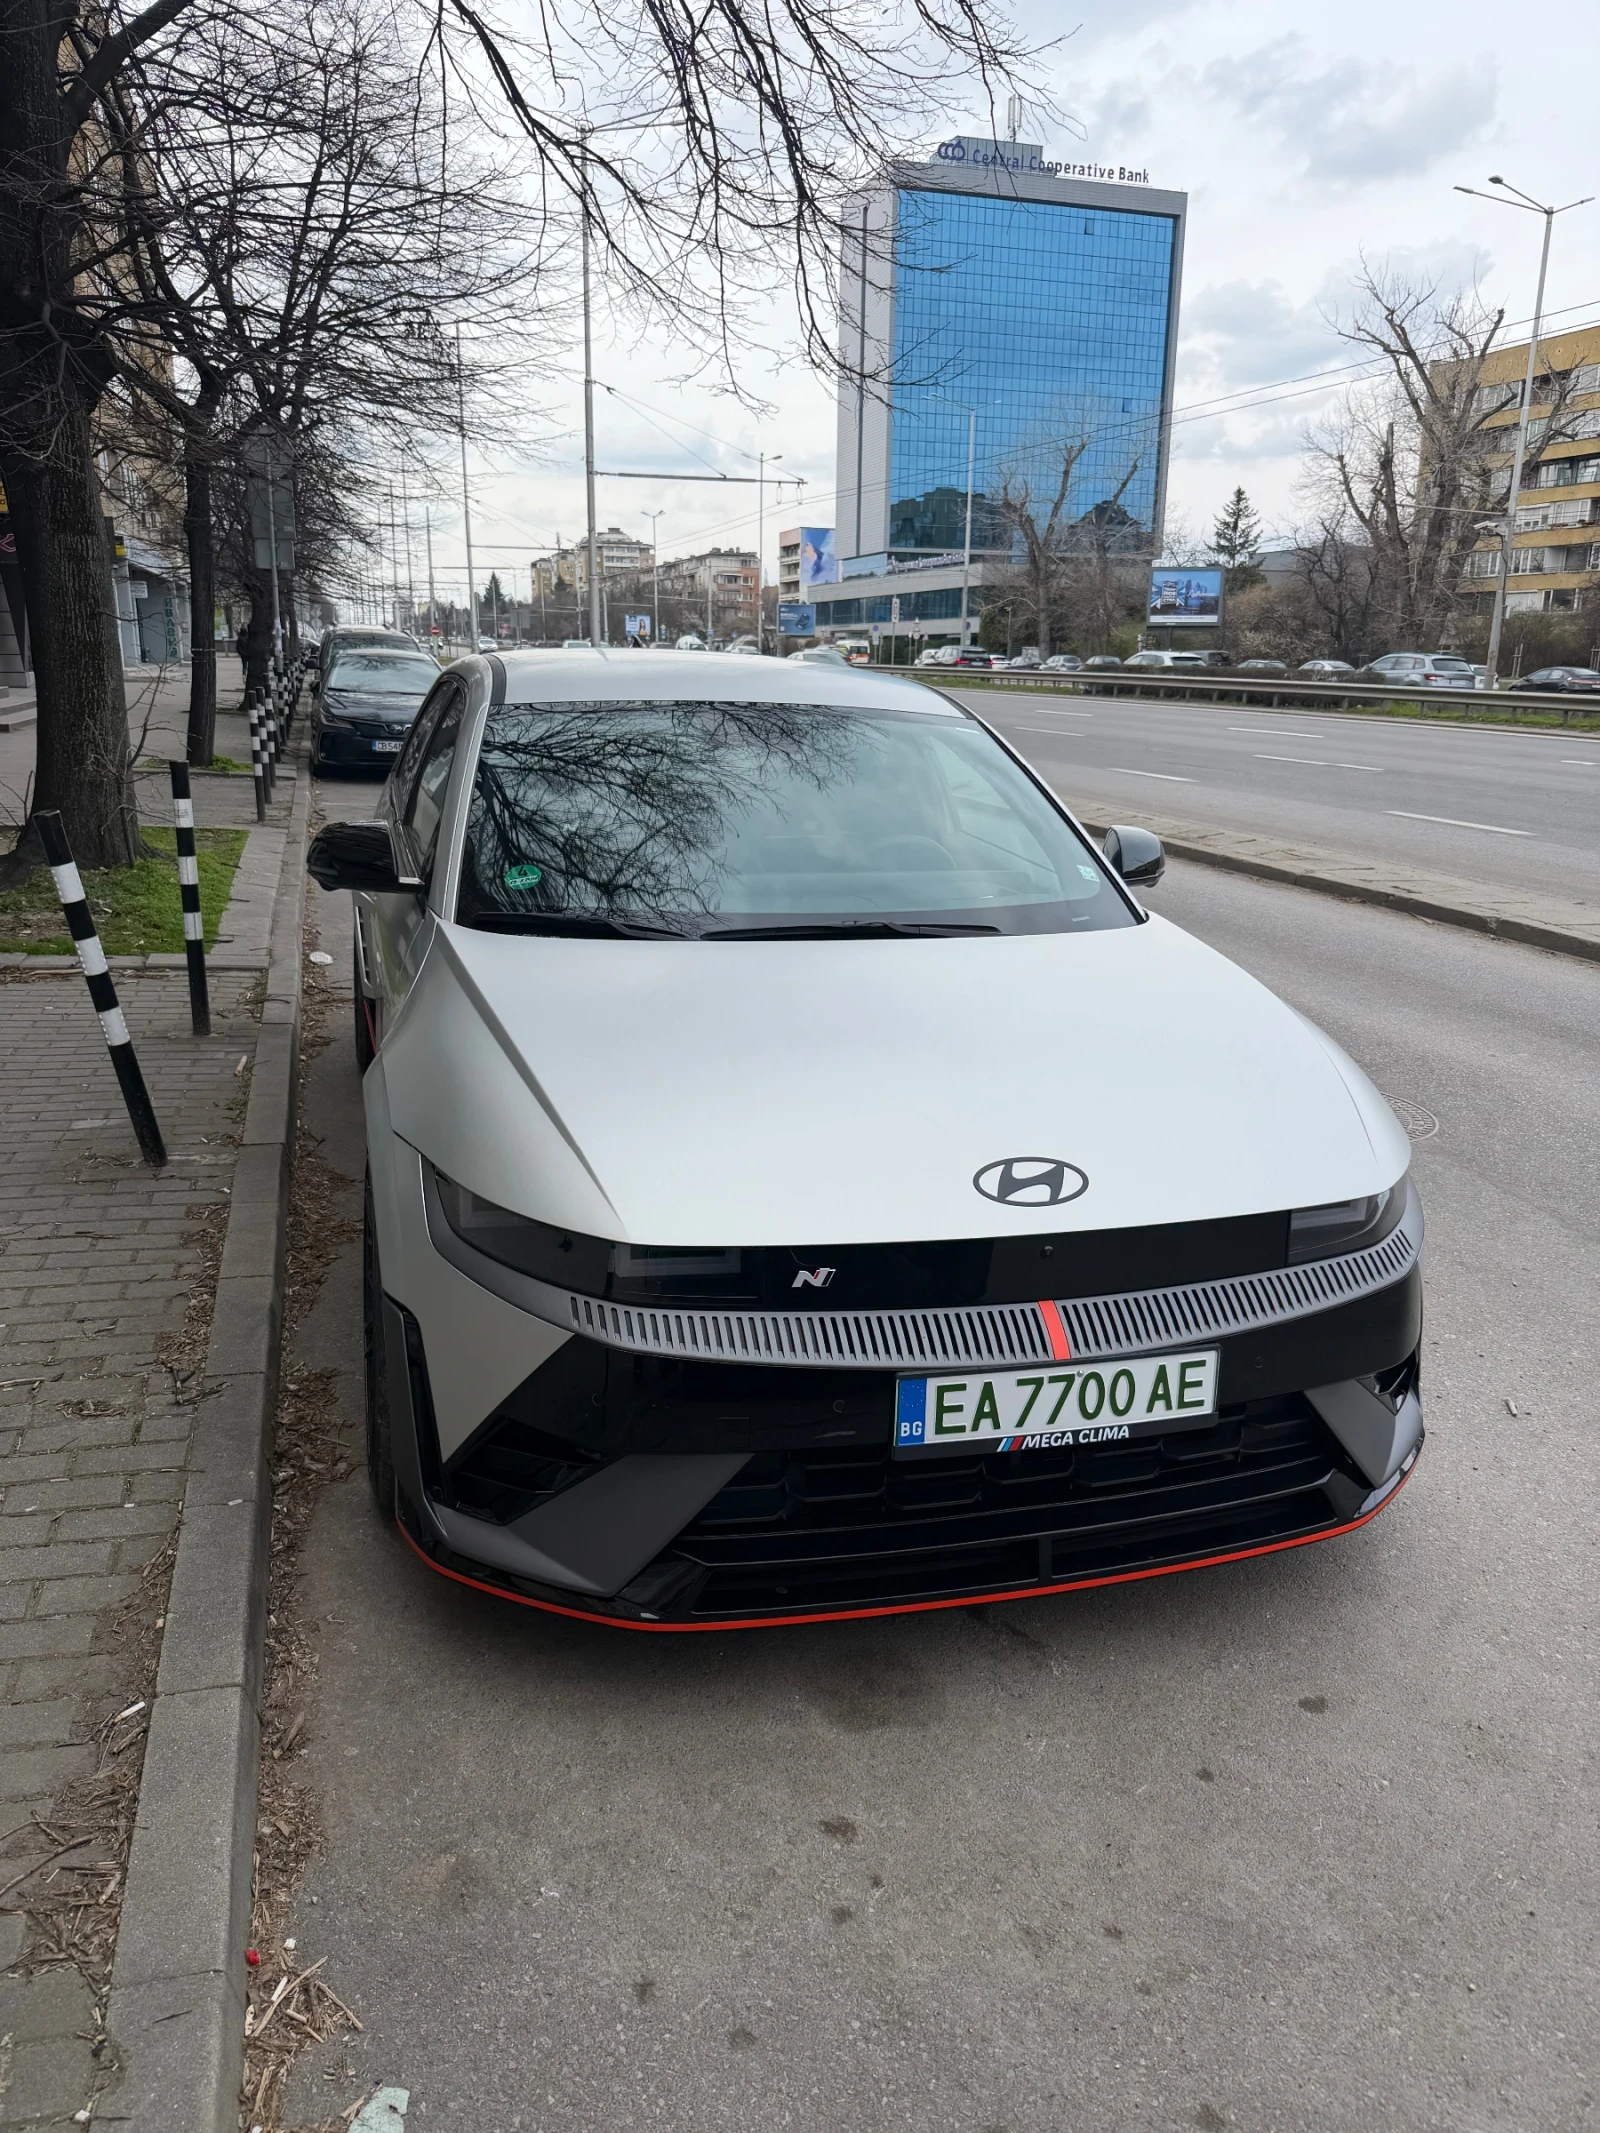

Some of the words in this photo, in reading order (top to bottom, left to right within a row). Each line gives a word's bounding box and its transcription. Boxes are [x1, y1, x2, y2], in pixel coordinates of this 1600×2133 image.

[973, 149, 1024, 170] Central
[1029, 155, 1114, 180] Cooperative
[1119, 166, 1149, 183] Bank
[935, 1381, 1001, 1435] EA
[1015, 1368, 1136, 1428] 7700
[1146, 1359, 1207, 1413] AE
[901, 1421, 923, 1437] BG
[1021, 1431, 1074, 1450] MEGA
[1078, 1425, 1130, 1443] CLIMA
